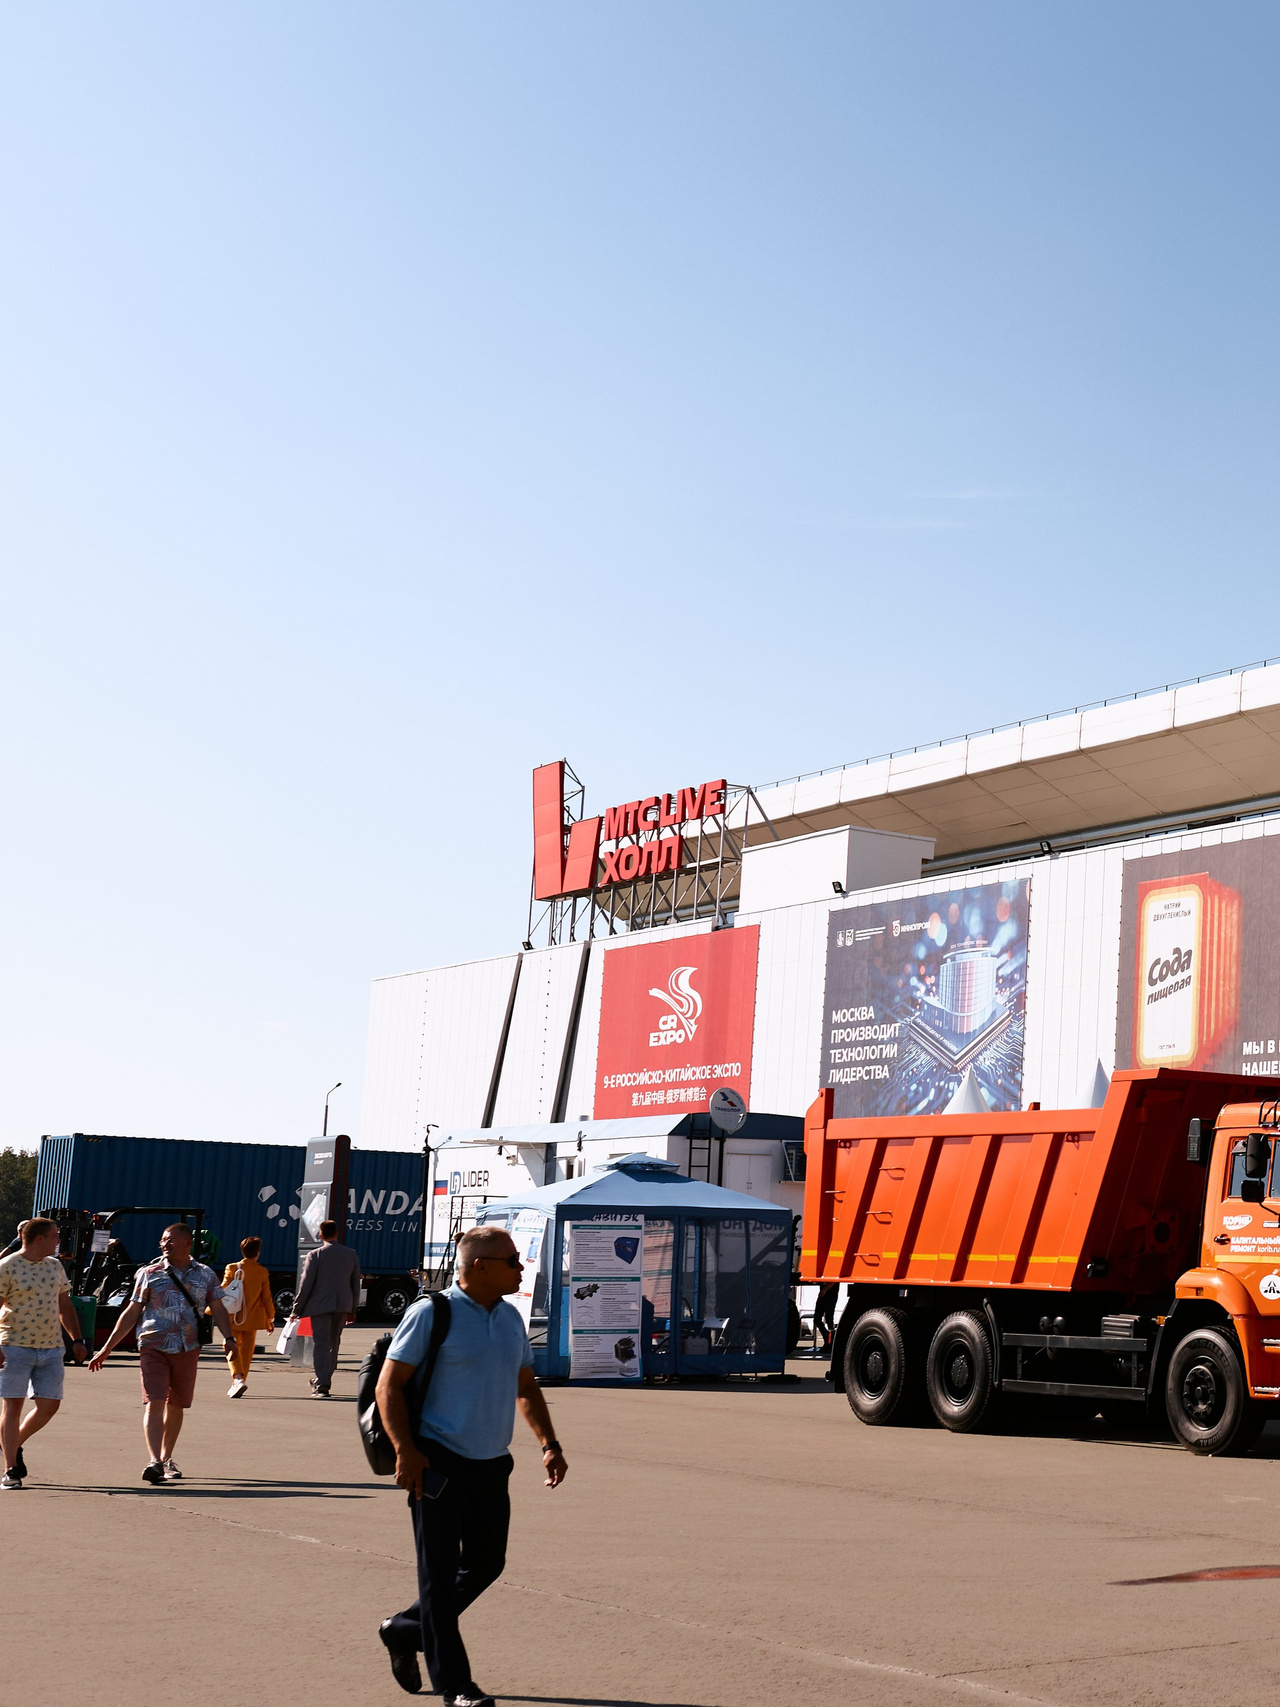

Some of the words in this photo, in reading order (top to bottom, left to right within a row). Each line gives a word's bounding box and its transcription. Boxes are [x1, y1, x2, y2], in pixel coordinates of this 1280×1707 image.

[659, 779, 727, 827] LIVE
[600, 834, 683, 887] ХОЛЛ
[1147, 947, 1193, 987] Сода
[1146, 974, 1192, 1006] пищевая
[831, 1005, 876, 1024] МОСКВА
[648, 1029, 686, 1047] EXPO
[830, 1022, 902, 1044] ПРОИЗВОДИТ
[829, 1043, 899, 1063] ТЕХНОЛОГИИ
[1242, 1041, 1264, 1055] МЫ
[1267, 1039, 1276, 1053] В
[615, 1063, 711, 1088] РОССИЙСКО-КИТАЙСКОЕ
[711, 1062, 742, 1079] ЭКСПО
[828, 1064, 890, 1085] ЛИДЕРСТВА
[462, 1170, 490, 1188] LIDER
[1230, 1235, 1280, 1245] КАПИТАЛЬНЫЙ
[1257, 1245, 1280, 1253] korib.ru
